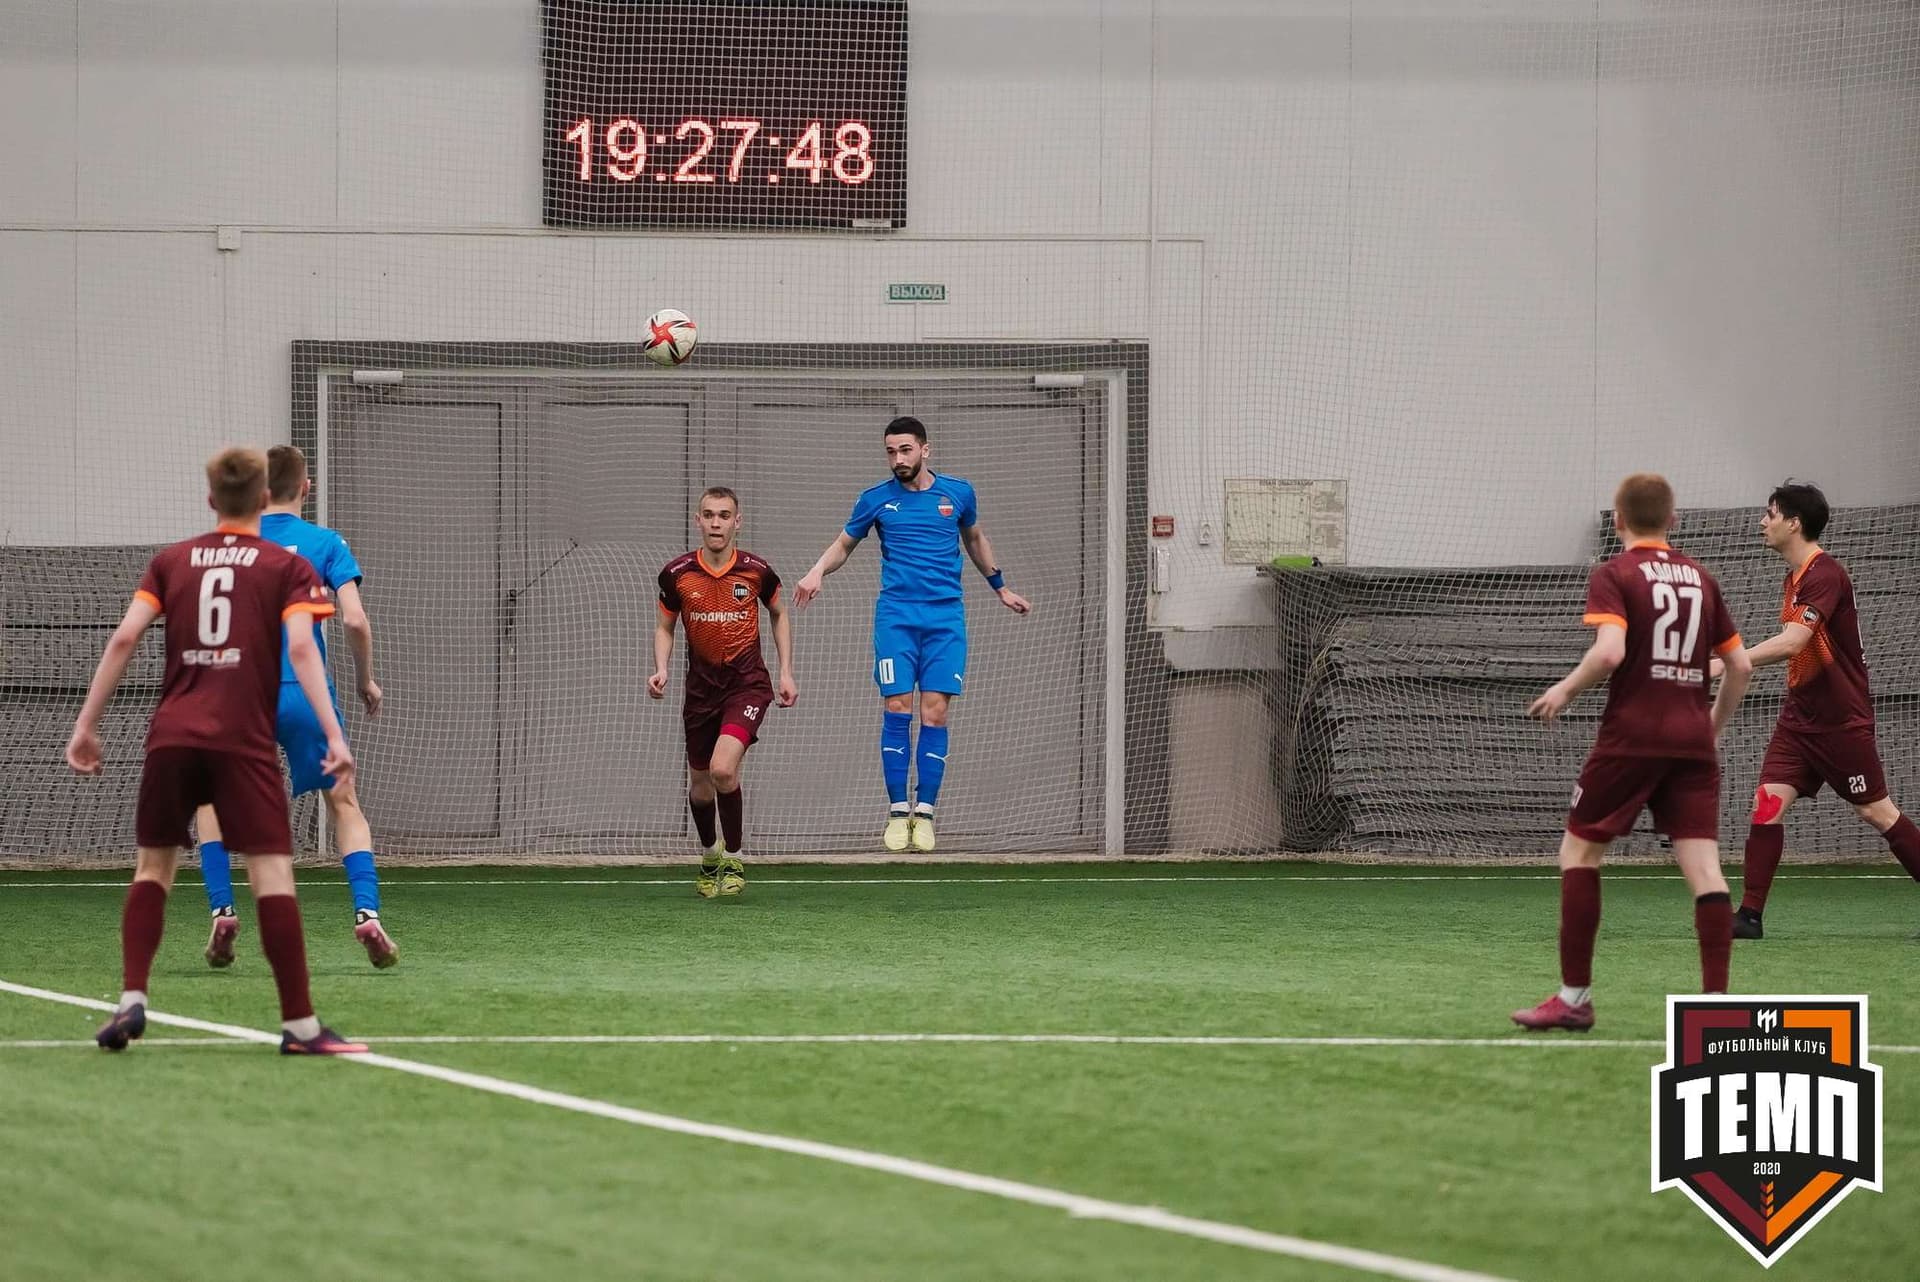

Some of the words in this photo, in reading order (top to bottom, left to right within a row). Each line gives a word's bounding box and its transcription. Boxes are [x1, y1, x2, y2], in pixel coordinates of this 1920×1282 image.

[566, 118, 875, 184] 19:27:48
[891, 286, 943, 300] ВЫХОД
[191, 547, 259, 567] КНЯЗЕВ
[1638, 561, 1702, 587] ЖДАНОВ
[198, 567, 235, 646] 6
[1651, 582, 1704, 664] 27
[182, 649, 240, 665] SEUS
[879, 658, 894, 684] 10
[1652, 665, 1703, 682] SEUS
[1848, 775, 1866, 793] 23
